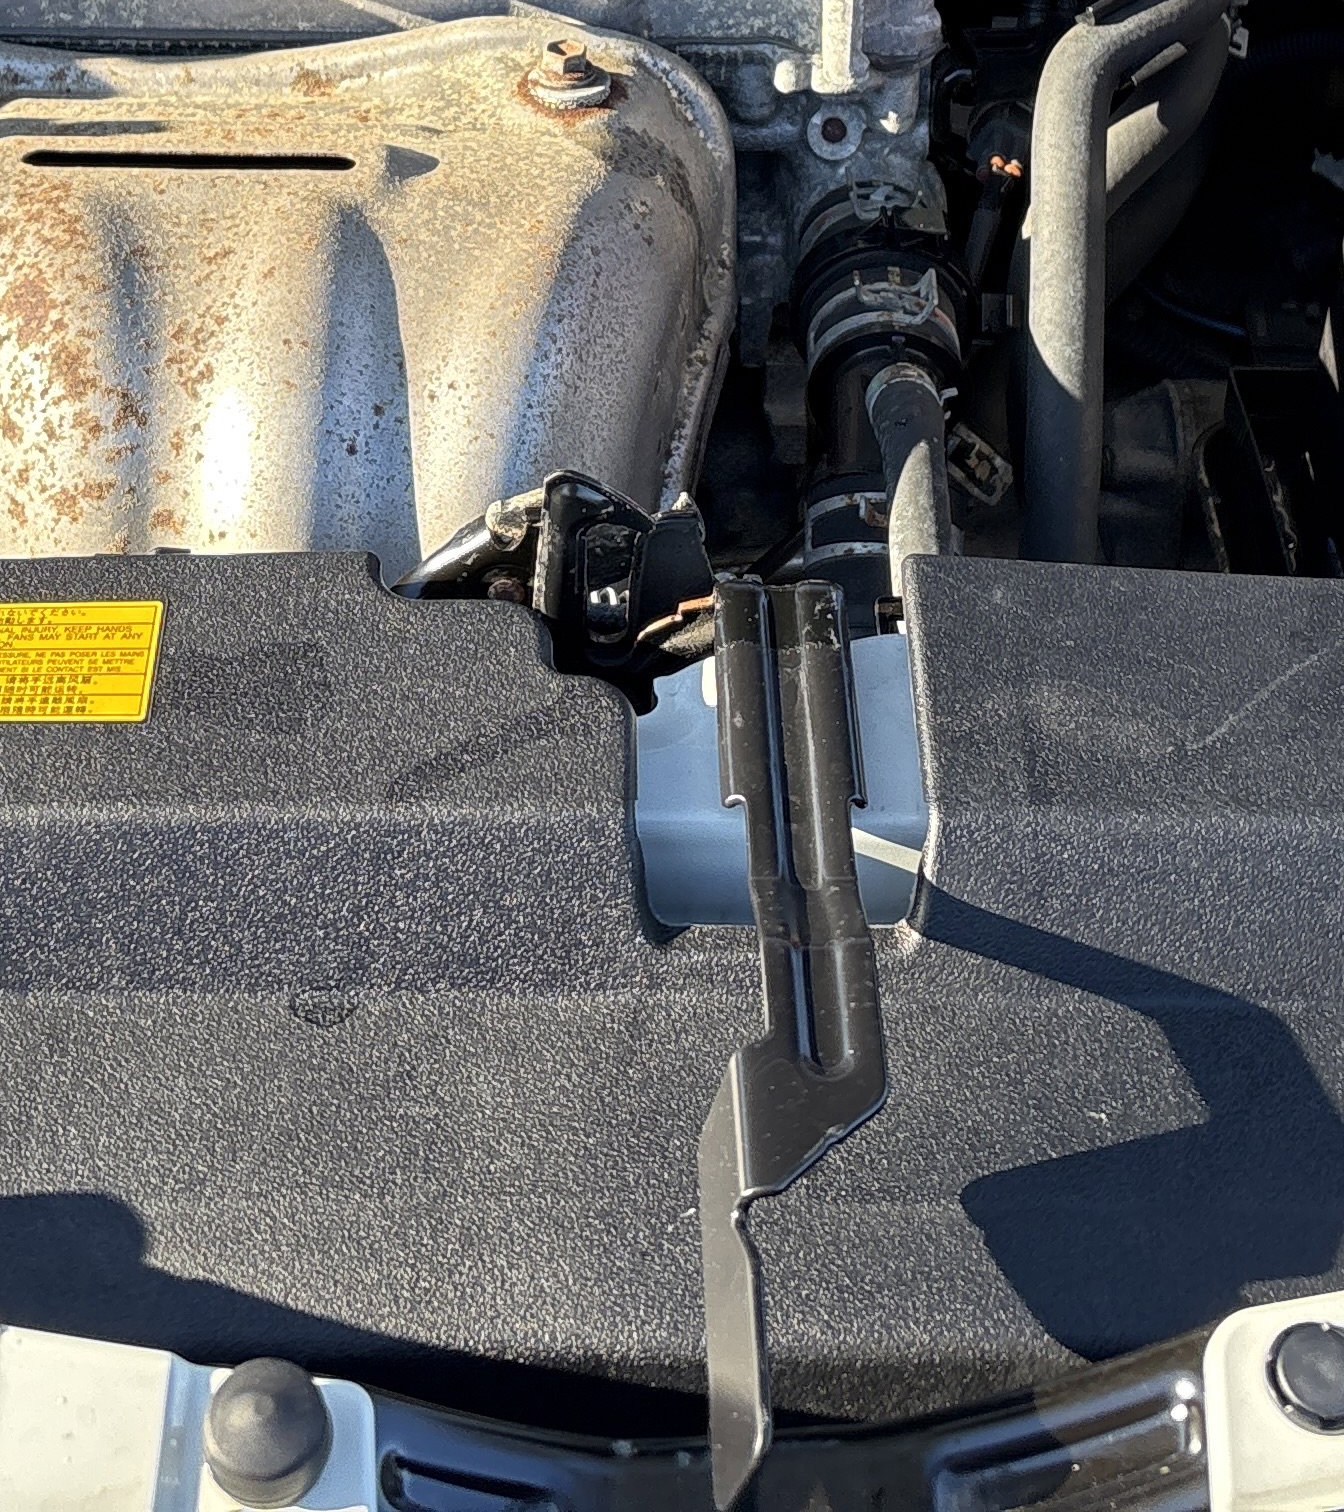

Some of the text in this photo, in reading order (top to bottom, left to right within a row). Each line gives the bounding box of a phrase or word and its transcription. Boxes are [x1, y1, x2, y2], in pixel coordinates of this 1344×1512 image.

[20, 626, 59, 635] INJURY,
[64, 625, 93, 633] KEEP
[96, 625, 133, 633] HANDS
[6, 633, 35, 641] FANS
[38, 633, 61, 641] MAY
[65, 632, 99, 641] START
[102, 632, 117, 640] AT
[120, 632, 144, 640] ANY
[119, 650, 145, 658] MAINS
[46, 665, 85, 673] CONTACT
